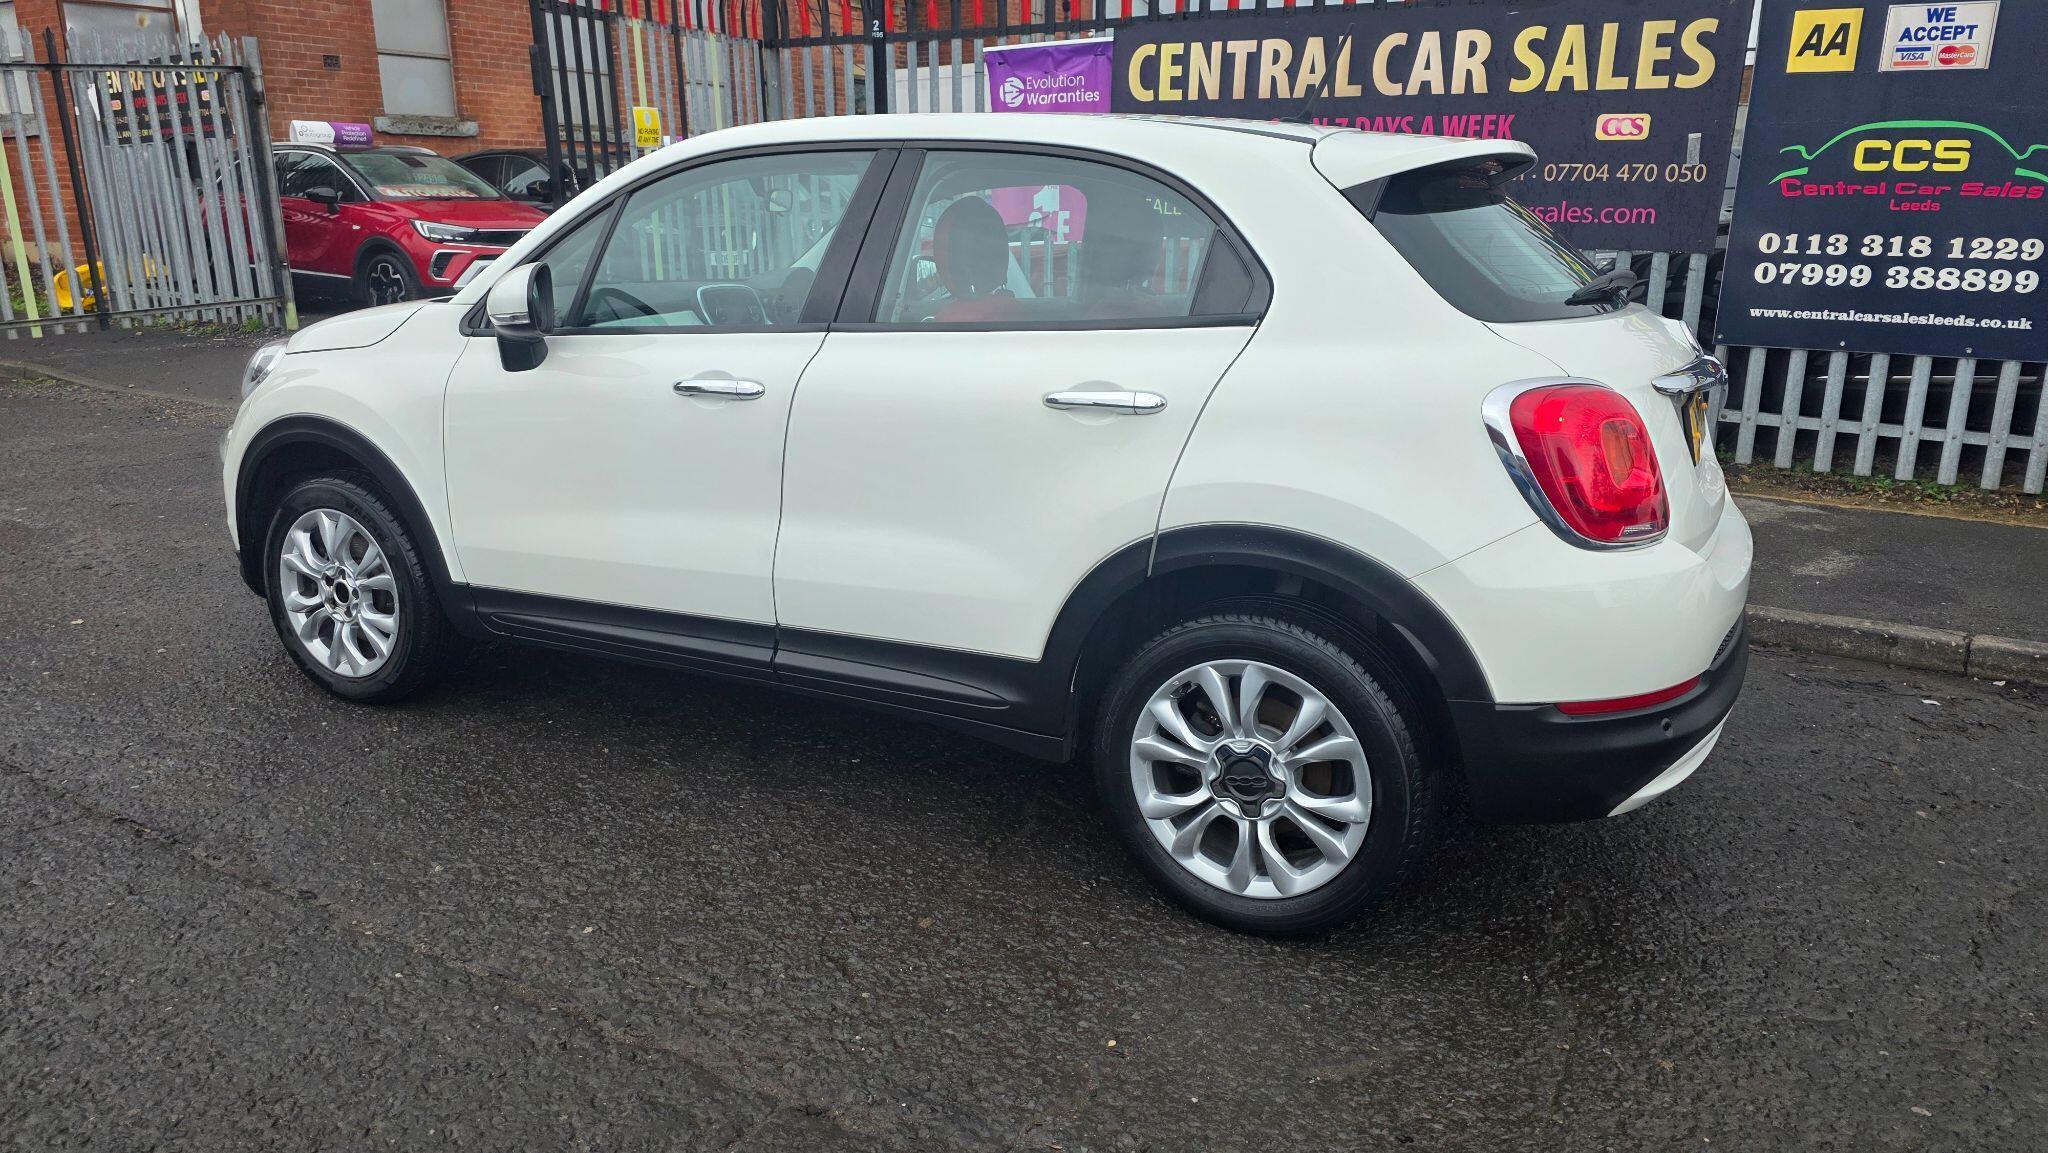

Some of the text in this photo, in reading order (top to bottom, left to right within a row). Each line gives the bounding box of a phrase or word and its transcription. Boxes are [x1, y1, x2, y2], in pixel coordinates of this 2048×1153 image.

[1927, 7, 1957, 23] WE
[872, 19, 880, 31] 2
[1899, 25, 1978, 42] ACCEPT
[1796, 22, 1852, 58] AA
[1128, 18, 1720, 102] CENTRAL CAR SALES
[1900, 52, 1925, 61] VISA
[1938, 51, 1975, 60] MasterCard
[1026, 74, 1085, 90] Evolution
[1026, 88, 1100, 106] Warranties
[1420, 115, 1434, 135] A
[1442, 114, 1516, 139] WEEK
[1853, 139, 1971, 172] CCS
[1544, 163, 1609, 182] 07704
[1616, 163, 1657, 182] 470
[1665, 163, 1707, 182] 050
[1780, 178, 2045, 199] Central Car Sales
[1890, 199, 1940, 212] Leeds
[1758, 232, 2045, 261] 0113 318 1229
[1753, 262, 2040, 293] 07999 388899
[1749, 307, 2033, 330] www.centralcarsalesleeds.co.uk
